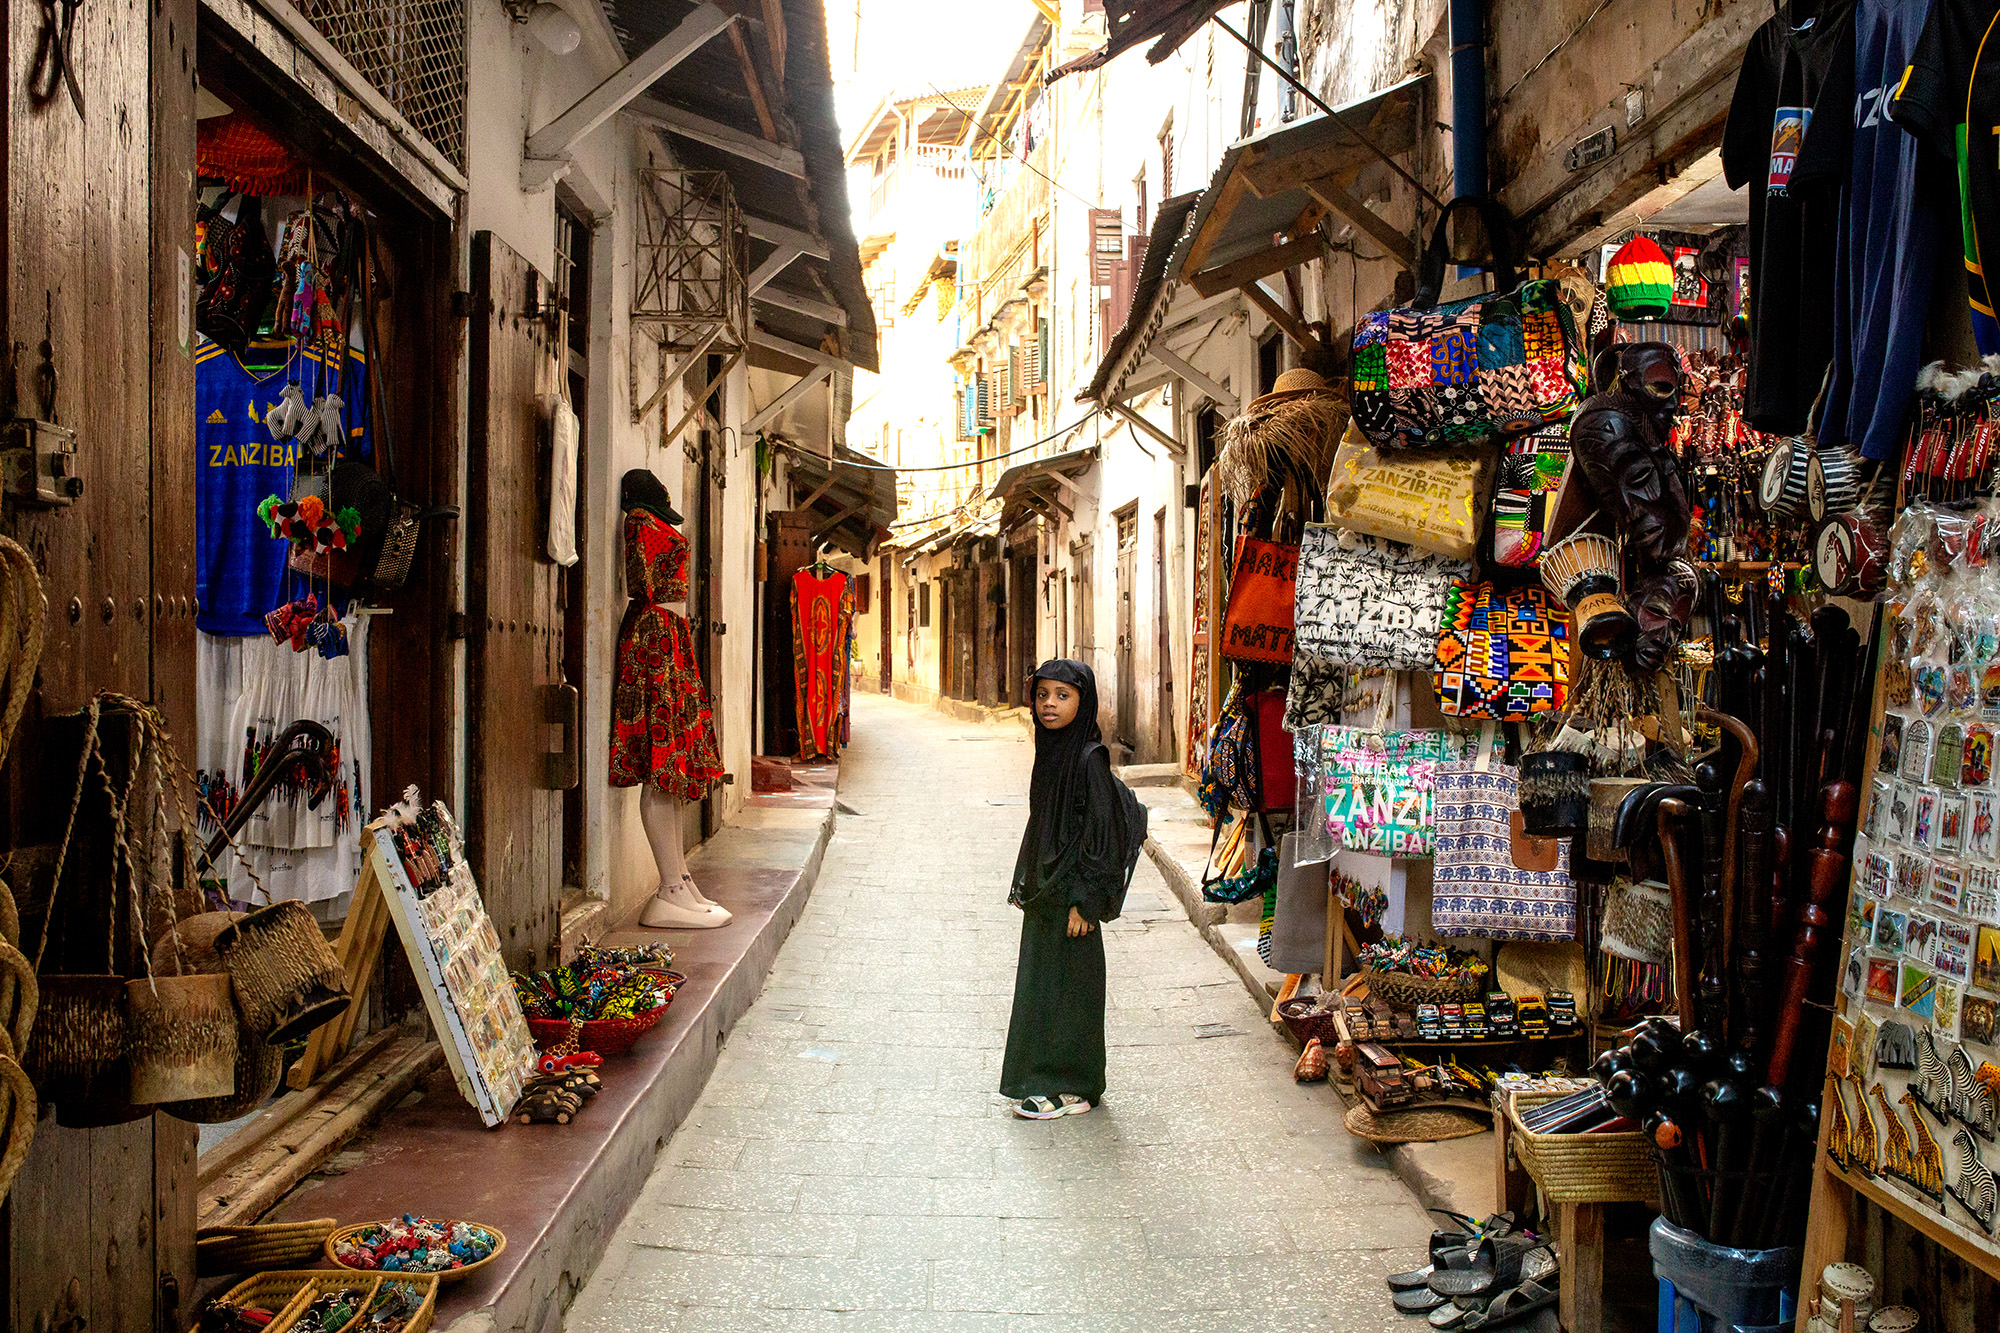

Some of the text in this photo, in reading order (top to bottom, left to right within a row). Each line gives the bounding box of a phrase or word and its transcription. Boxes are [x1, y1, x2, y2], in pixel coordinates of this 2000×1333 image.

[1362, 468, 1452, 501] ZANZIBAR
[1337, 762, 1409, 777] ZANZIBAR
[1336, 776, 1370, 785] ZANZIBAR
